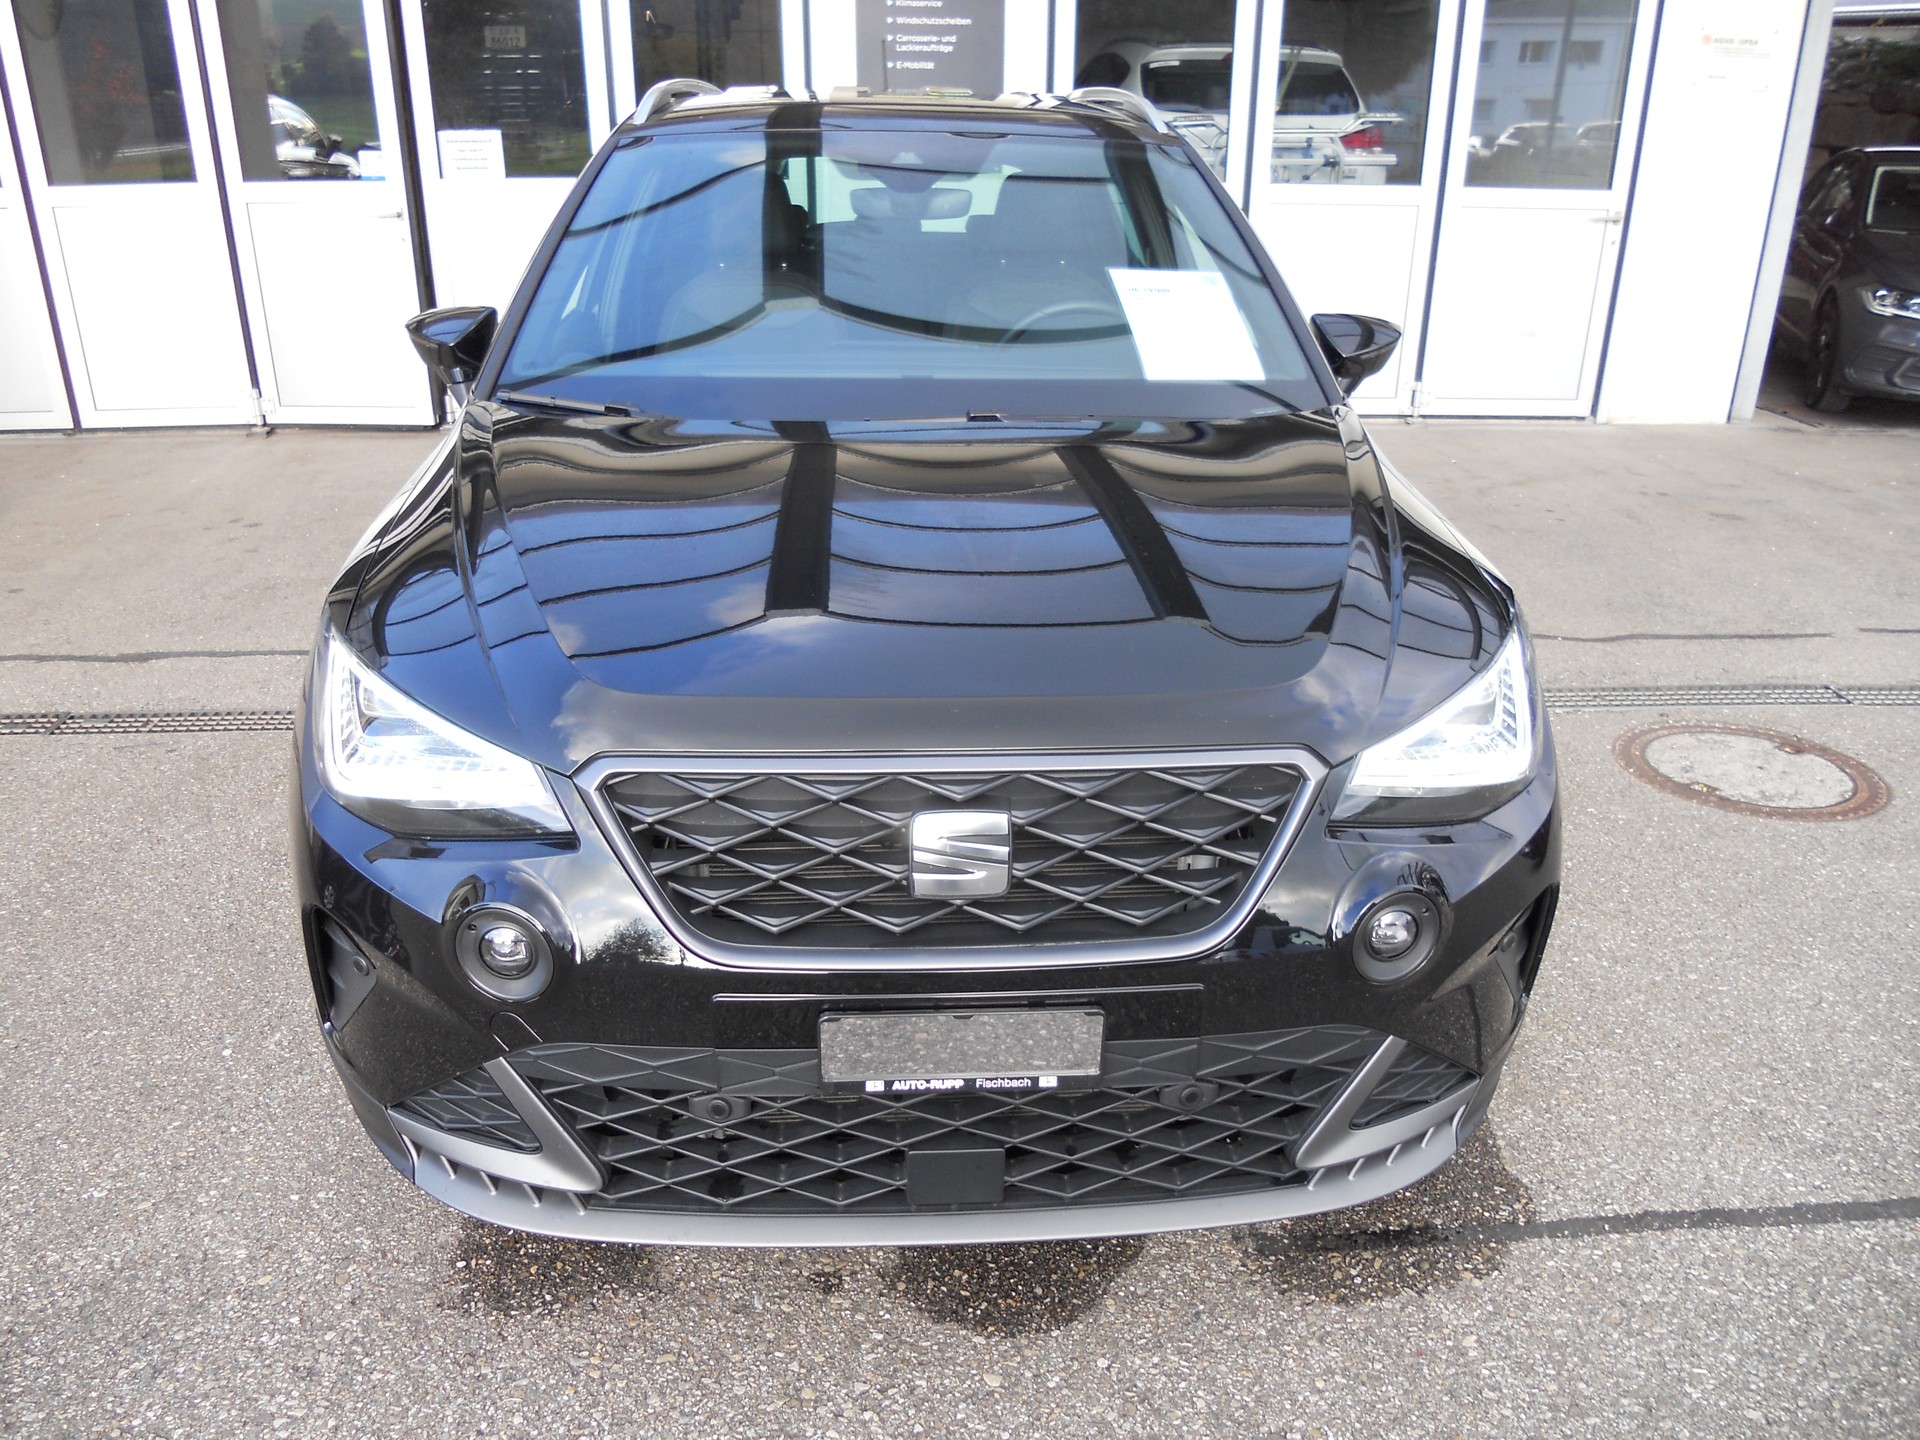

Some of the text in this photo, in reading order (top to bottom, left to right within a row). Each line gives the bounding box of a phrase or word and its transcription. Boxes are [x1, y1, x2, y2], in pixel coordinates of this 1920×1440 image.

[896, 0, 943, 8] Klimaservice
[896, 16, 972, 25] Windschutzscheiben
[896, 34, 957, 43] Carrosserie- und
[896, 44, 954, 54] Lackieraufträge
[896, 61, 935, 70] E-Mobilität
[892, 1078, 1031, 1091] AUTO-RUPP Fischbach
